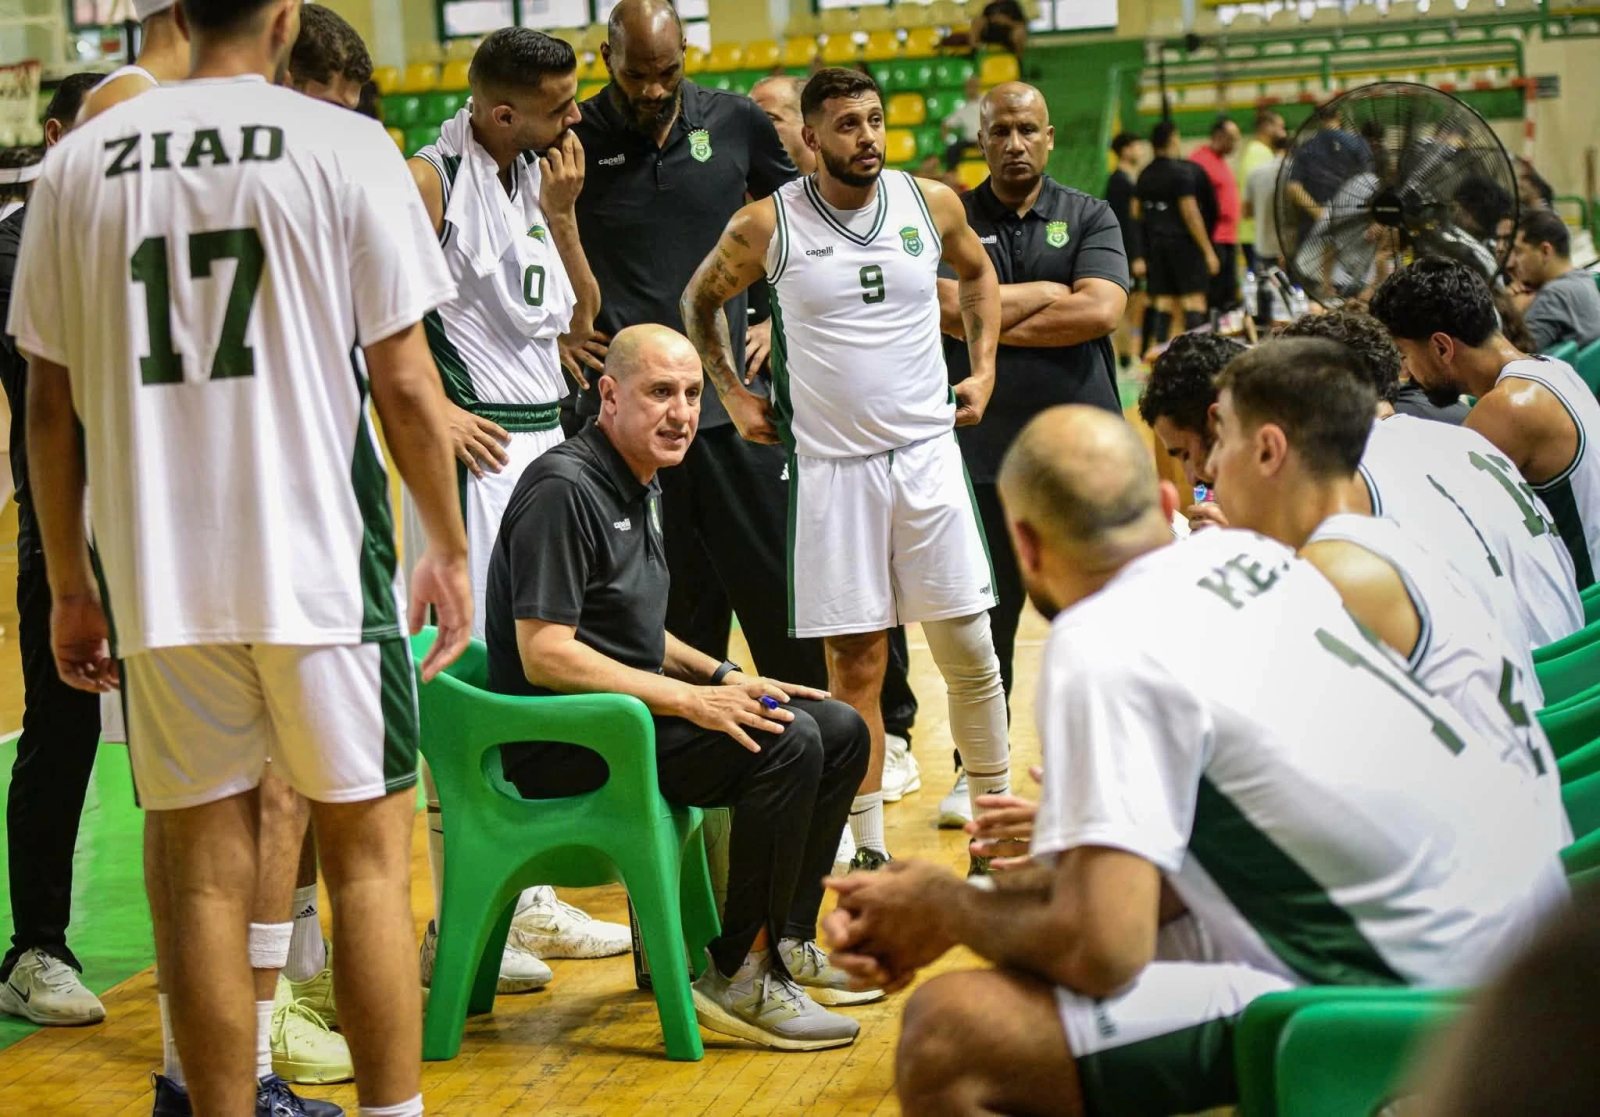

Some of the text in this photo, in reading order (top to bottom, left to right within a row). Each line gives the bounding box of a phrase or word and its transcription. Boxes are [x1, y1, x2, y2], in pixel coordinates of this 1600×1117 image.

[104, 125, 283, 178] ZIAD
[523, 265, 545, 306] 0
[859, 265, 885, 304] 9
[131, 232, 265, 385] 17
